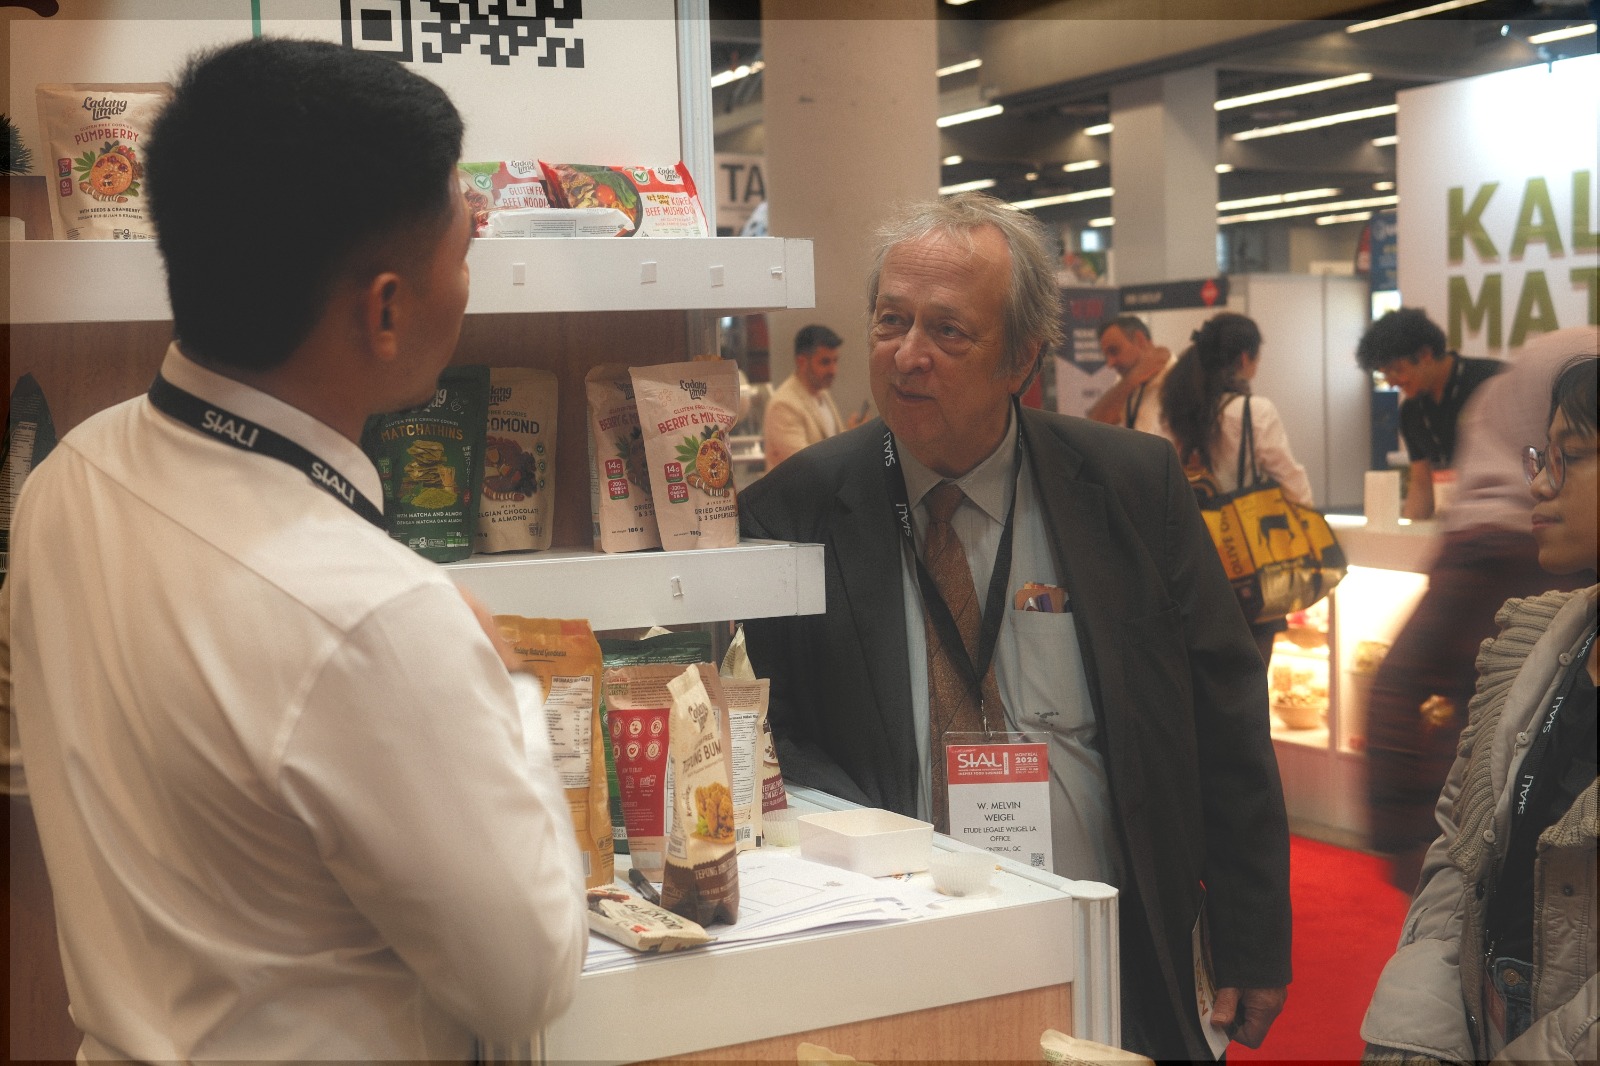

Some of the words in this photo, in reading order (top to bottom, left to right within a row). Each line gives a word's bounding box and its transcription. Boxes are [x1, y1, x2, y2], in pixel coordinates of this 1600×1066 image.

[74, 128, 139, 145] PUMPBERRY
[508, 186, 534, 196] GLUTEN
[673, 405, 694, 415] GLUTEN
[486, 417, 540, 435] OMOND
[657, 415, 690, 434] BERRY
[690, 413, 700, 425] &
[700, 411, 717, 424] MIX
[381, 423, 464, 442] MATCHATHINS
[498, 515, 527, 523] ALMOND
[957, 752, 1003, 769] SIAL
[1015, 756, 1038, 764] 2026
[976, 802, 989, 810] W.
[990, 801, 1021, 810] MELVIN
[983, 813, 1016, 822] WEIGEL
